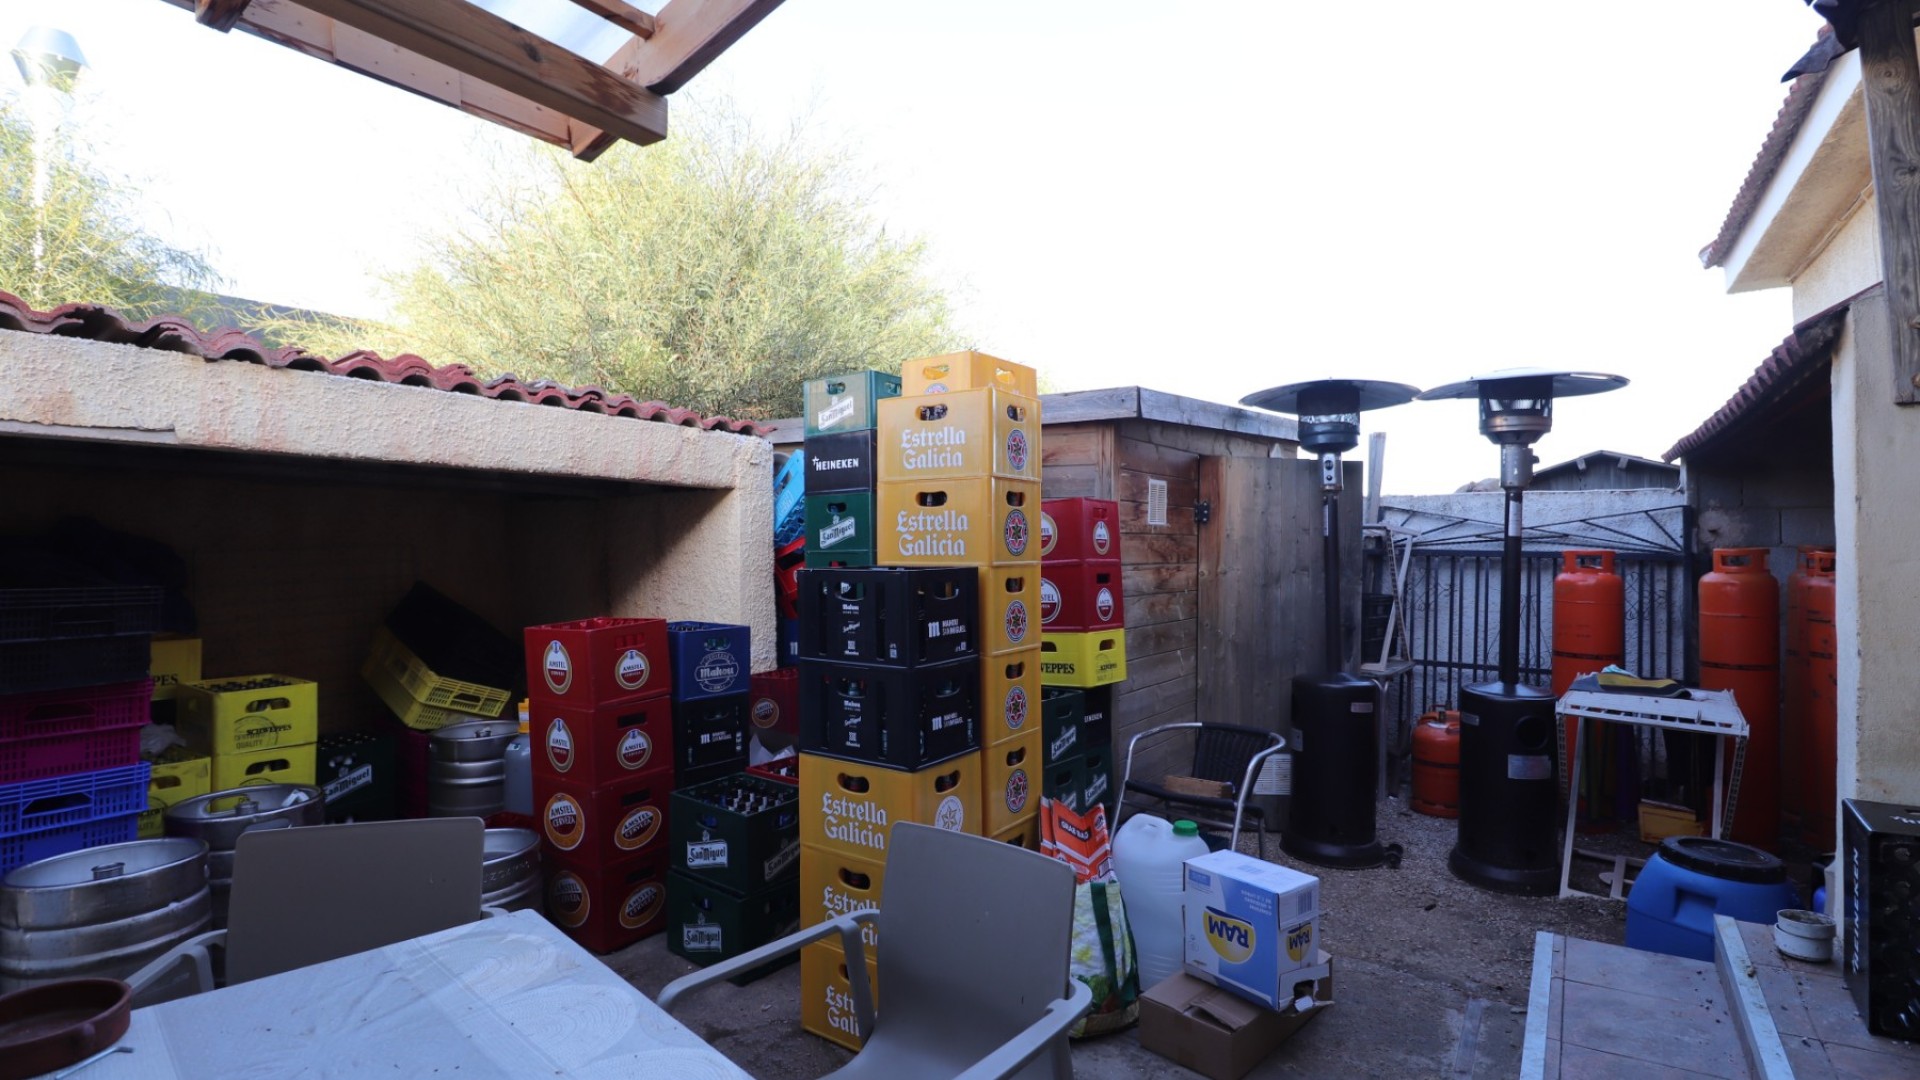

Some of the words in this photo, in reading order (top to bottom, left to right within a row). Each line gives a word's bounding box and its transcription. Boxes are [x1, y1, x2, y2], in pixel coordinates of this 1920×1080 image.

[901, 427, 966, 449] Estrella
[815, 458, 859, 471] HEINEKEN
[903, 450, 963, 470] Galicia
[896, 510, 968, 532] Estrella
[899, 535, 966, 557] Galicia
[1041, 663, 1075, 674] EPPES
[551, 805, 574, 817] AMSTEL
[821, 792, 887, 826] Estrella
[824, 815, 885, 850] Galicia
[1208, 915, 1249, 949] RAM
[1289, 929, 1311, 950] RAM
[827, 1006, 860, 1037] Gali
